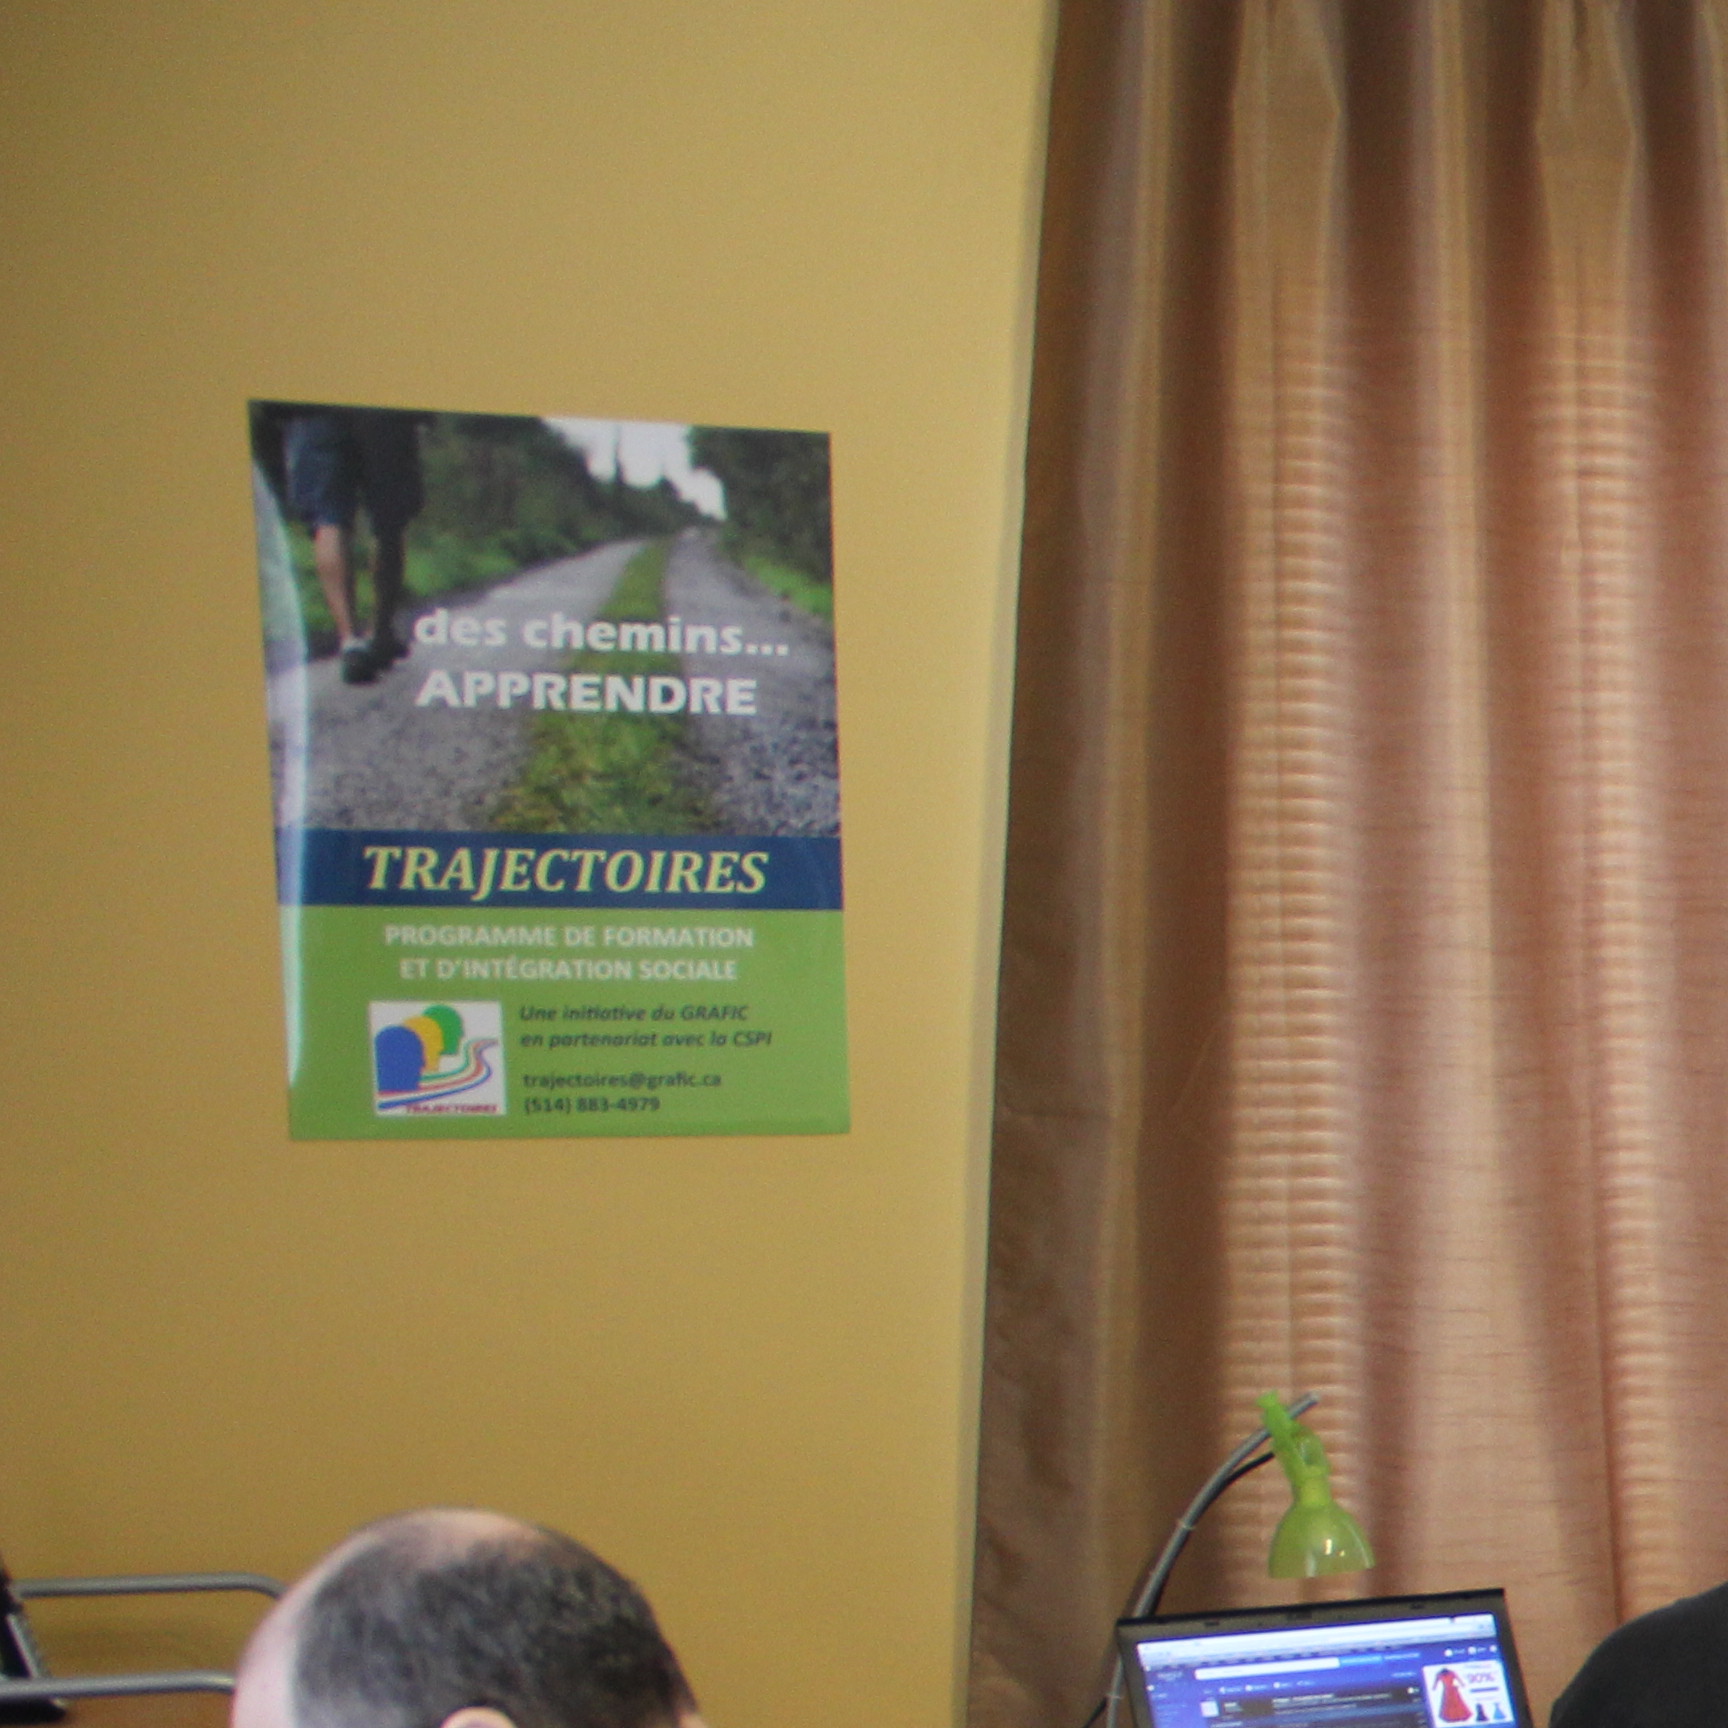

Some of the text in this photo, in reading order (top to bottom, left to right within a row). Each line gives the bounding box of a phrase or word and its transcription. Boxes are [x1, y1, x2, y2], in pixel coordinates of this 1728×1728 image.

[413, 607, 791, 658] des chemins...
[415, 668, 759, 716] APPRENDRE
[363, 845, 770, 902] TRAJECTOIRES
[384, 923, 755, 951] PROGRAMME DE FORMATION
[400, 952, 739, 984] ET D'INTÉGRATION SOCIALE
[520, 1004, 750, 1022] Une initiative du GRAFIC
[519, 1031, 773, 1050] en partenariat avec la CSPI
[523, 1072, 722, 1092] trajectoires@grafic.ca
[523, 1097, 572, 1116] (514)
